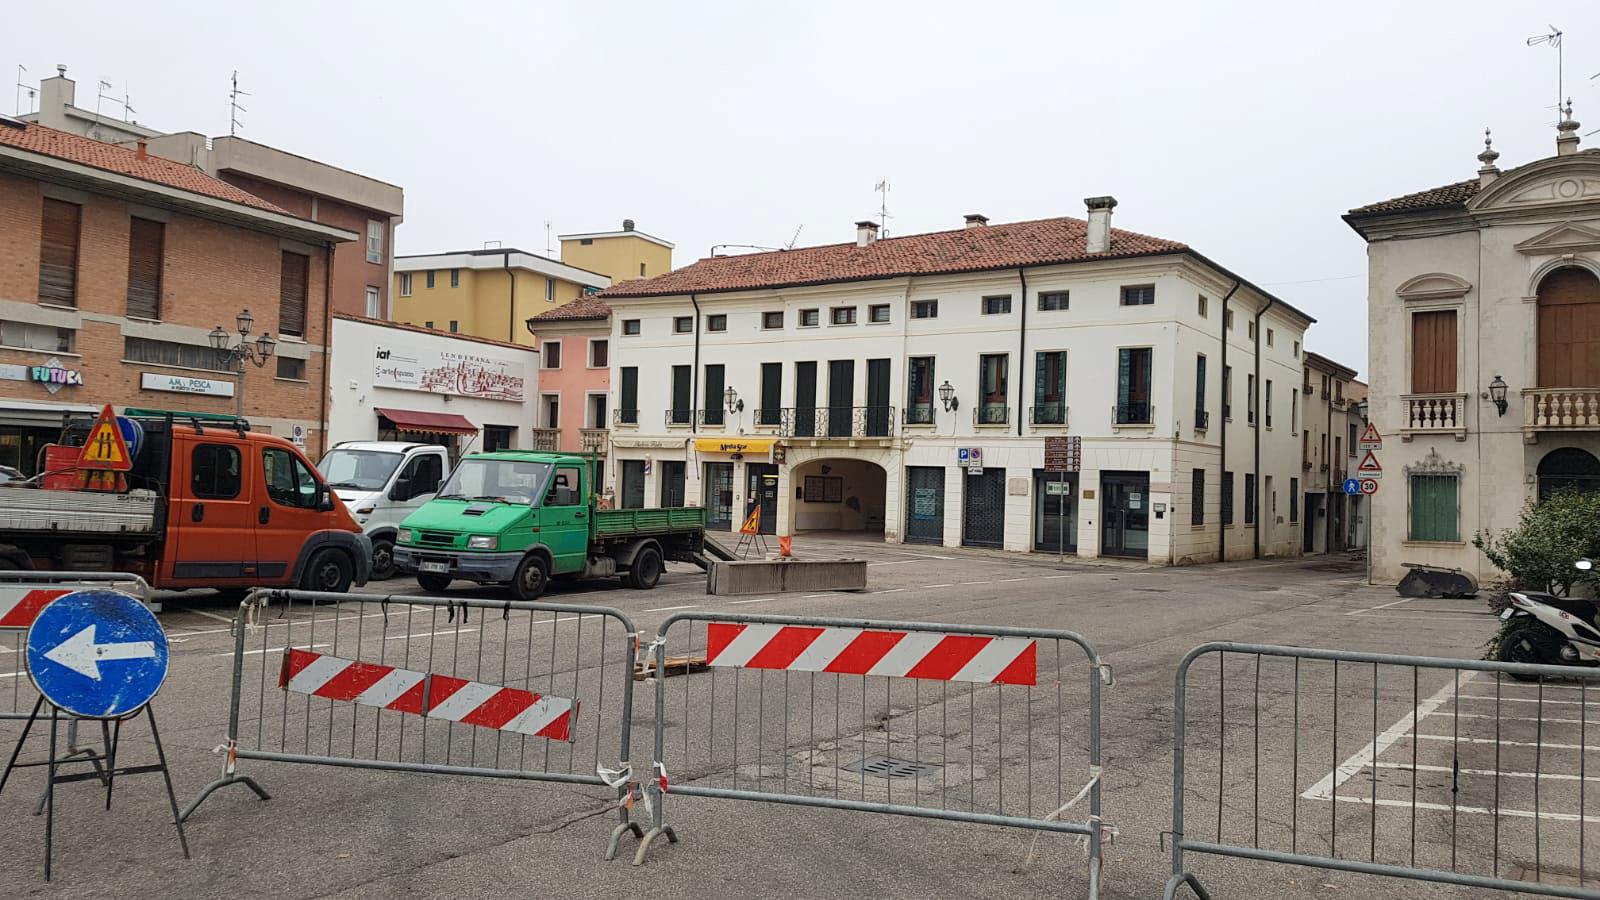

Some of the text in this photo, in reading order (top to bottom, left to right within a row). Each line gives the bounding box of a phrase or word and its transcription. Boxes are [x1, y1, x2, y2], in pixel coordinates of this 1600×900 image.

[376, 346, 391, 360] iat
[32, 367, 83, 385] FUTURA
[960, 450, 967, 458] P
